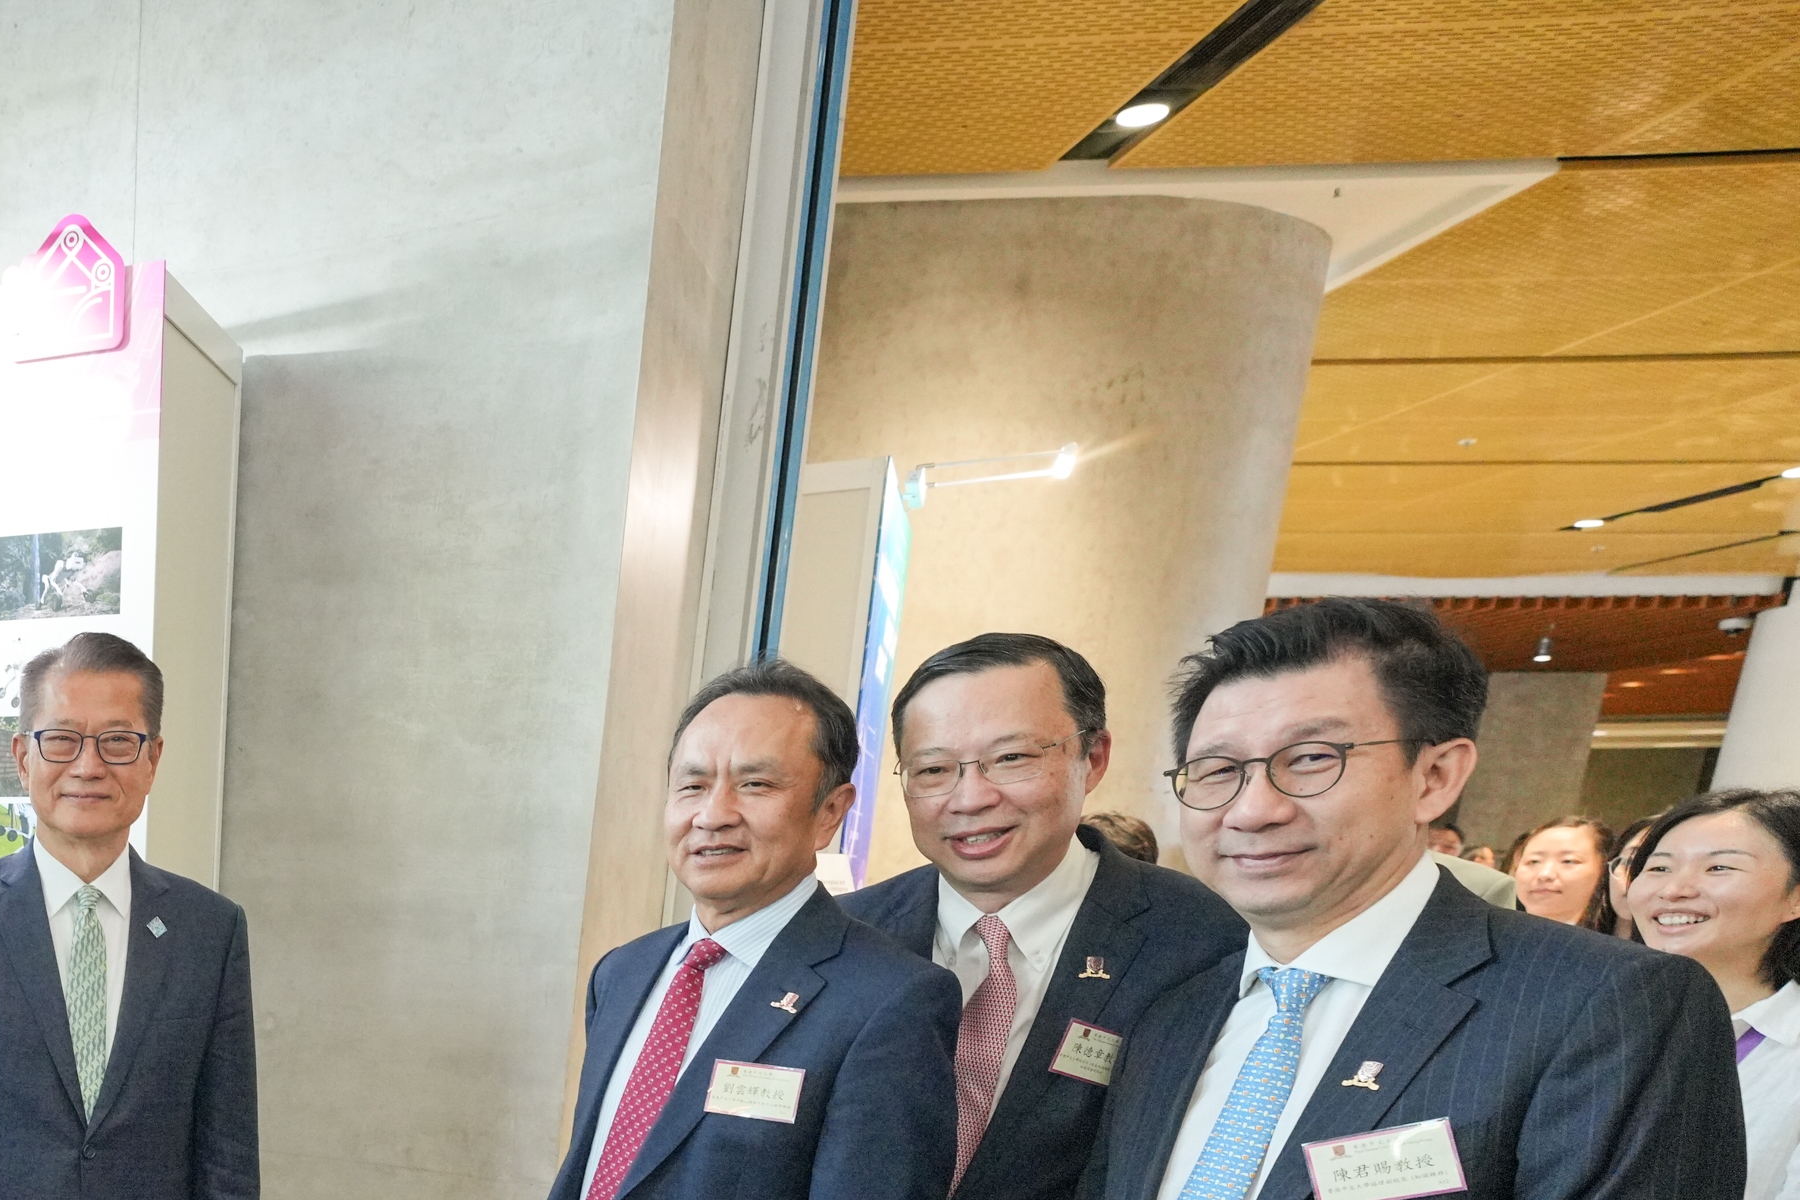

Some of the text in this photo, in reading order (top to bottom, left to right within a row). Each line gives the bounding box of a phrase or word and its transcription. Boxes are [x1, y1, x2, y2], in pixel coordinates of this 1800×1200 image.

[722, 1083, 784, 1101] 劉雲輝教授
[1333, 1154, 1435, 1183] 陳君賜教授
